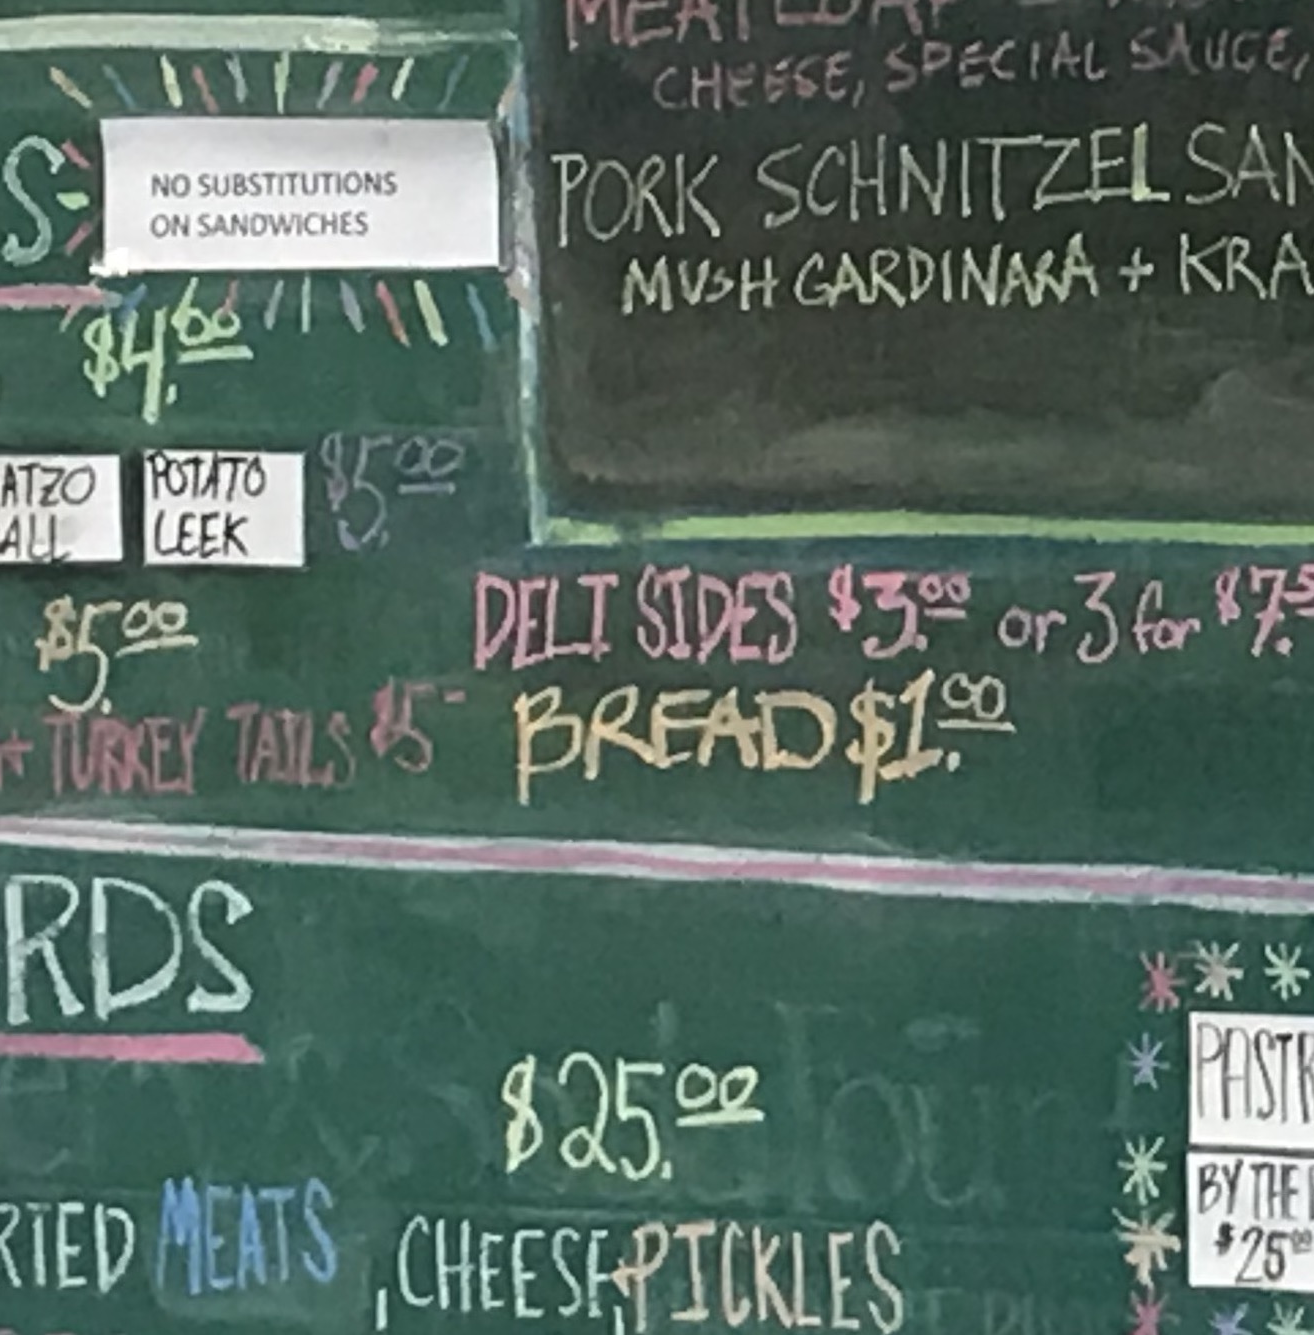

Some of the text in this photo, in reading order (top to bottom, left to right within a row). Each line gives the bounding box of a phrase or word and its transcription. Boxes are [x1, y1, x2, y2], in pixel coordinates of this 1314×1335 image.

[652, 52, 865, 111] CHEESE,
[886, 35, 1107, 91] SPECIAL
[150, 170, 398, 198] NO SUBSTITUTIONS
[551, 151, 721, 248] PORK
[756, 123, 1171, 228] SCHNITZEL
[150, 212, 369, 239] ON SANDWICHES
[621, 256, 779, 316] MUSH
[147, 451, 265, 502] POTATO
[154, 511, 249, 557] LEEK
[476, 568, 620, 667] DELI
[636, 565, 800, 662] SIDES
[998, 604, 1066, 652] or
[1076, 571, 1119, 663] 3
[1132, 580, 1200, 654] for
[44, 706, 207, 796] TURKEY
[226, 704, 355, 790] TAILS
[514, 684, 835, 804] BREAD
[1198, 1158, 1244, 1215] BY
[1249, 1161, 1299, 1219] THE
